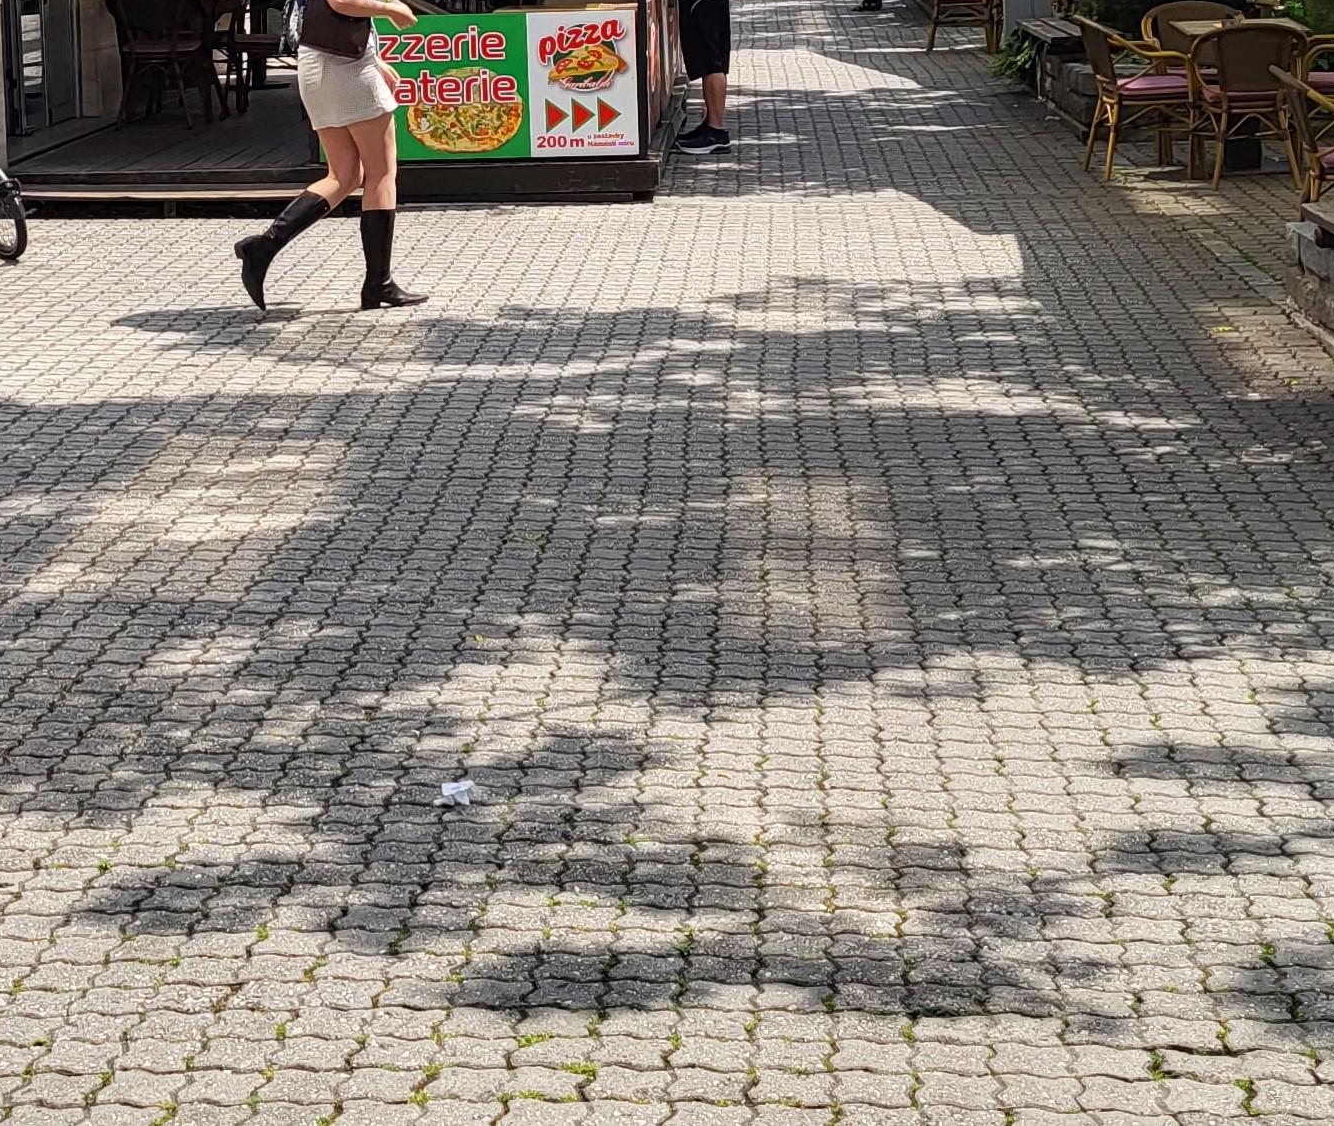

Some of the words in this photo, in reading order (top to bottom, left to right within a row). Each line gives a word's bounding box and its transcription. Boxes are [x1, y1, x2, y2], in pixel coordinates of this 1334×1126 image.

[378, 26, 507, 62] zzerie
[538, 18, 627, 66] pizza
[395, 70, 518, 106] aterie
[536, 134, 567, 149] 200
[569, 136, 585, 149] m
